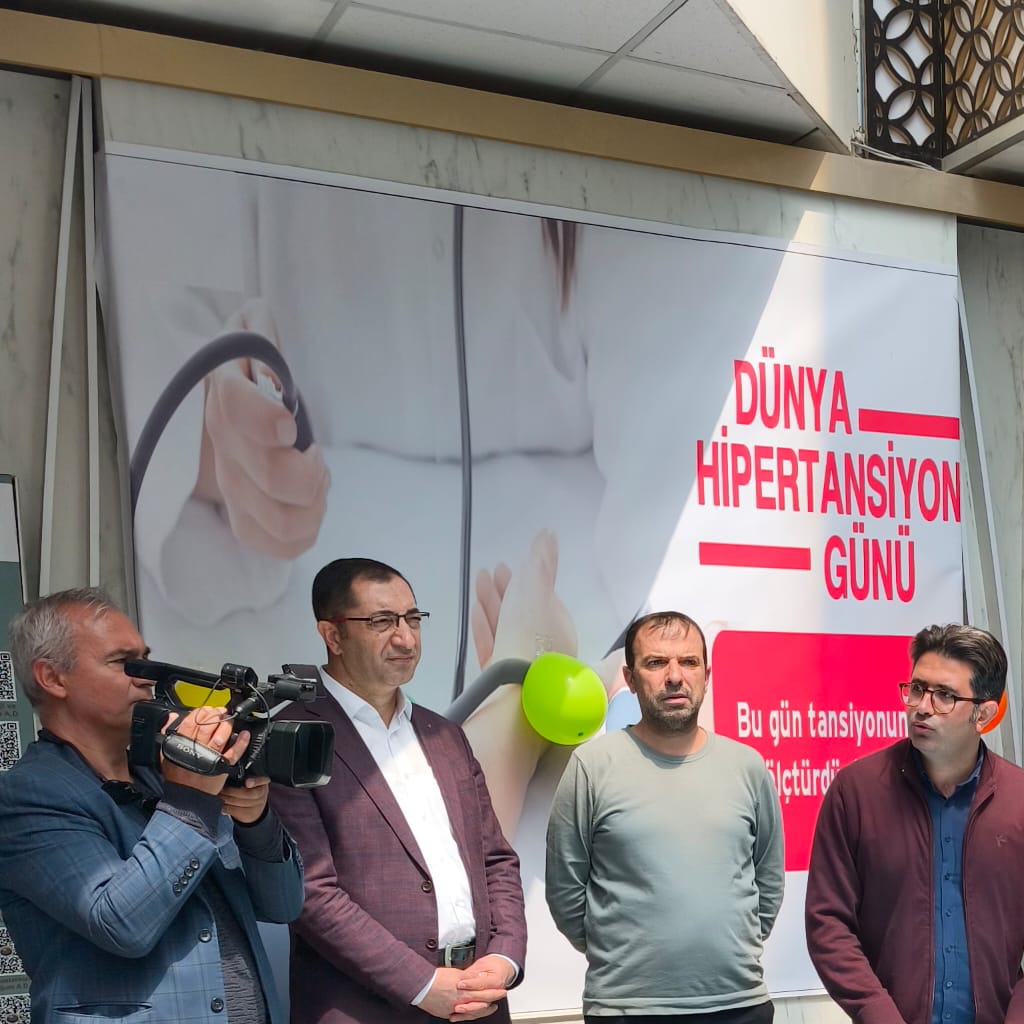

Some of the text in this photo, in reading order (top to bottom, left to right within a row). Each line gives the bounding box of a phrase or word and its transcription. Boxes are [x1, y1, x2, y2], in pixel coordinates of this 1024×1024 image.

[734, 346, 852, 435] DÜNYA
[696, 425, 960, 522] HİPERTANSİYON
[824, 522, 915, 603] GÜNÜ
[176, 743, 200, 759] SONY
[737, 701, 763, 738] Bu
[769, 700, 803, 747] gün
